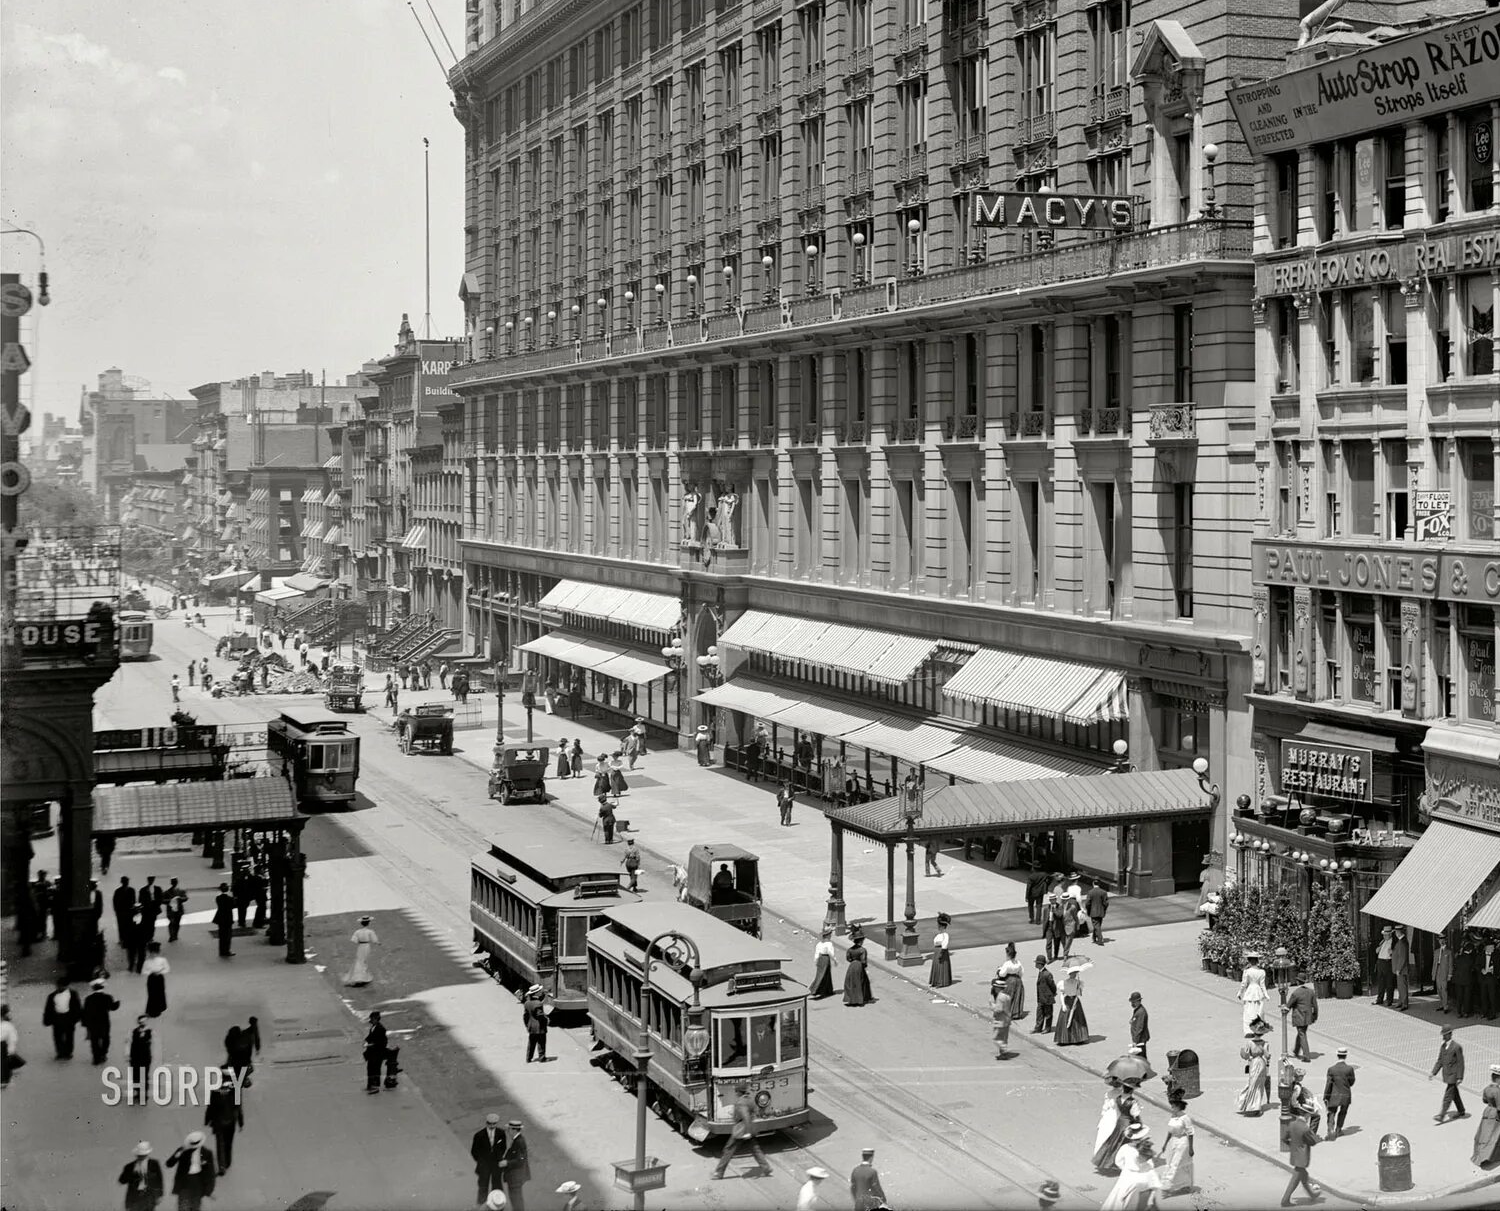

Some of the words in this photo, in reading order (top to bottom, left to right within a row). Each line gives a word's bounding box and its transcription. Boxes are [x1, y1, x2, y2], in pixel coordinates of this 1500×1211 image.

[1444, 24, 1481, 44] SAFETY
[1317, 53, 1420, 107] AutoStrop
[1236, 85, 1281, 105] STROPPING
[1374, 88, 1426, 116] Strops
[1428, 72, 1469, 102] Itself
[1257, 103, 1272, 115] AND
[1293, 107, 1303, 119] IN
[1303, 103, 1318, 116] THE
[1249, 114, 1288, 133] CLEANING
[1253, 128, 1295, 147] PERFECTED
[1475, 130, 1490, 145] Lee
[975, 194, 1133, 226] MACY'S
[1414, 240, 1458, 274] REAL
[1320, 254, 1351, 286] FOX
[1353, 253, 1366, 279] &
[1418, 501, 1429, 509] TO
[1431, 501, 1449, 509] LET
[1429, 493, 1449, 501] FLOOR
[1416, 510, 1451, 542] FOX
[1265, 548, 1330, 585] PAUL
[1338, 552, 1438, 593] JONES
[1451, 559, 1468, 595] &
[1470, 640, 1490, 659] Paul
[1469, 680, 1489, 699] Pure
[1287, 747, 1362, 773] MURRAY'S
[1281, 768, 1368, 797] RESTAURANT
[1351, 828, 1406, 848] CAFE
[751, 1077, 789, 1092] 933
